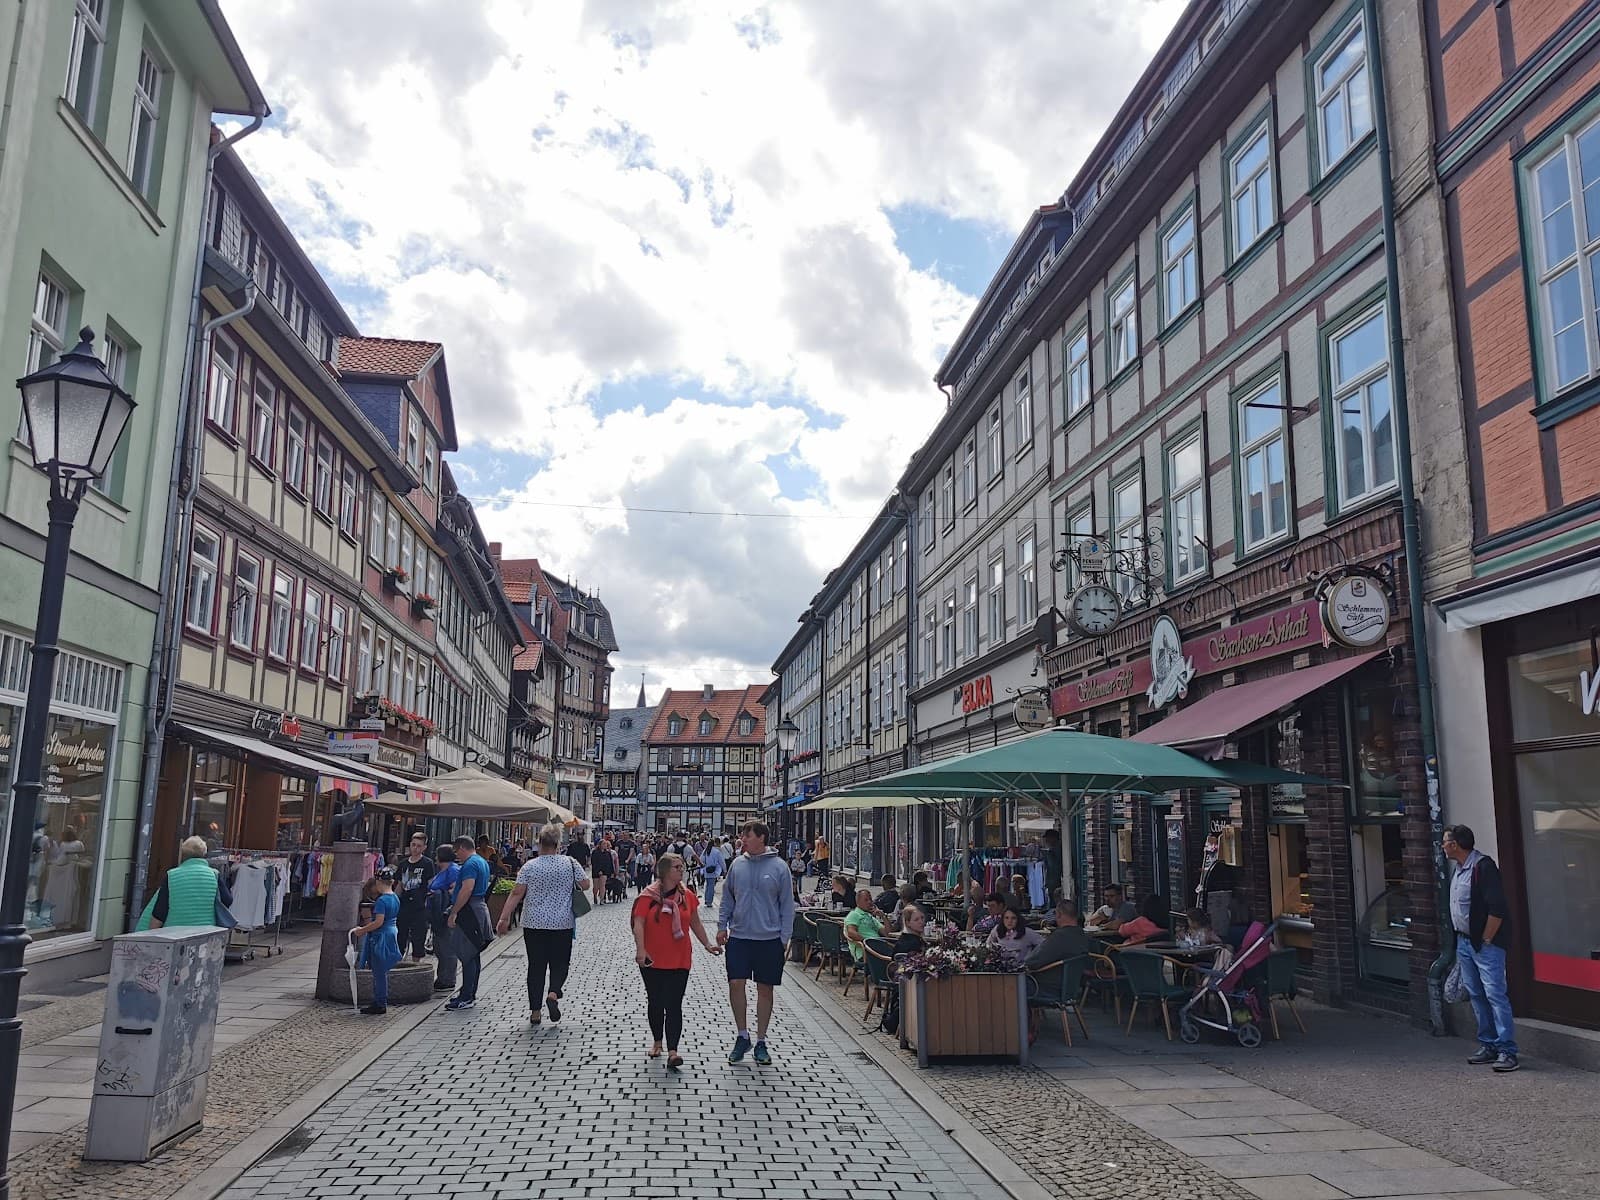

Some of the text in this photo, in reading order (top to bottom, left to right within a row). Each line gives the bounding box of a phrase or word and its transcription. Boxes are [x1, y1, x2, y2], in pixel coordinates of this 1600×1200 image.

[1208, 608, 1309, 663] Sachsen-Anhalt
[962, 673, 994, 713] ELKA
[46, 731, 106, 765] Strumpfmoden
